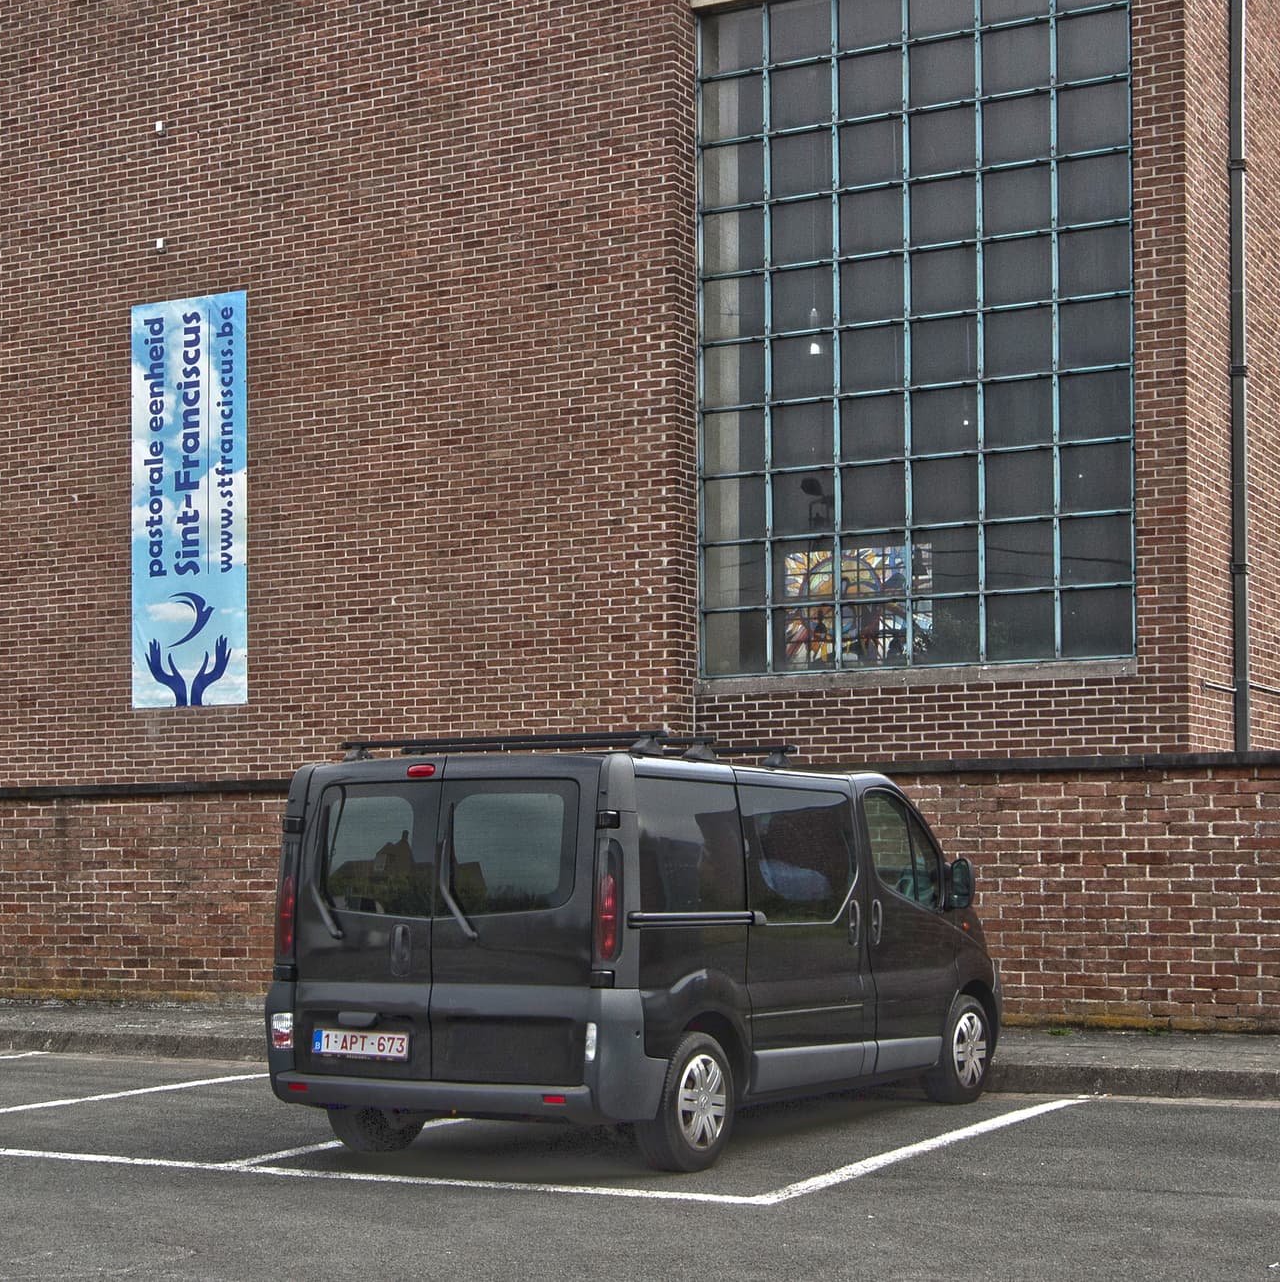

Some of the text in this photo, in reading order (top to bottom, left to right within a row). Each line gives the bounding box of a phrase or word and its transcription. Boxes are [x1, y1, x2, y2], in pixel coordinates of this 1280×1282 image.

[144, 317, 167, 577] pastorale eenheid
[174, 312, 201, 575] Sint-Franciscus
[216, 307, 233, 572] www.stfranciscus.be
